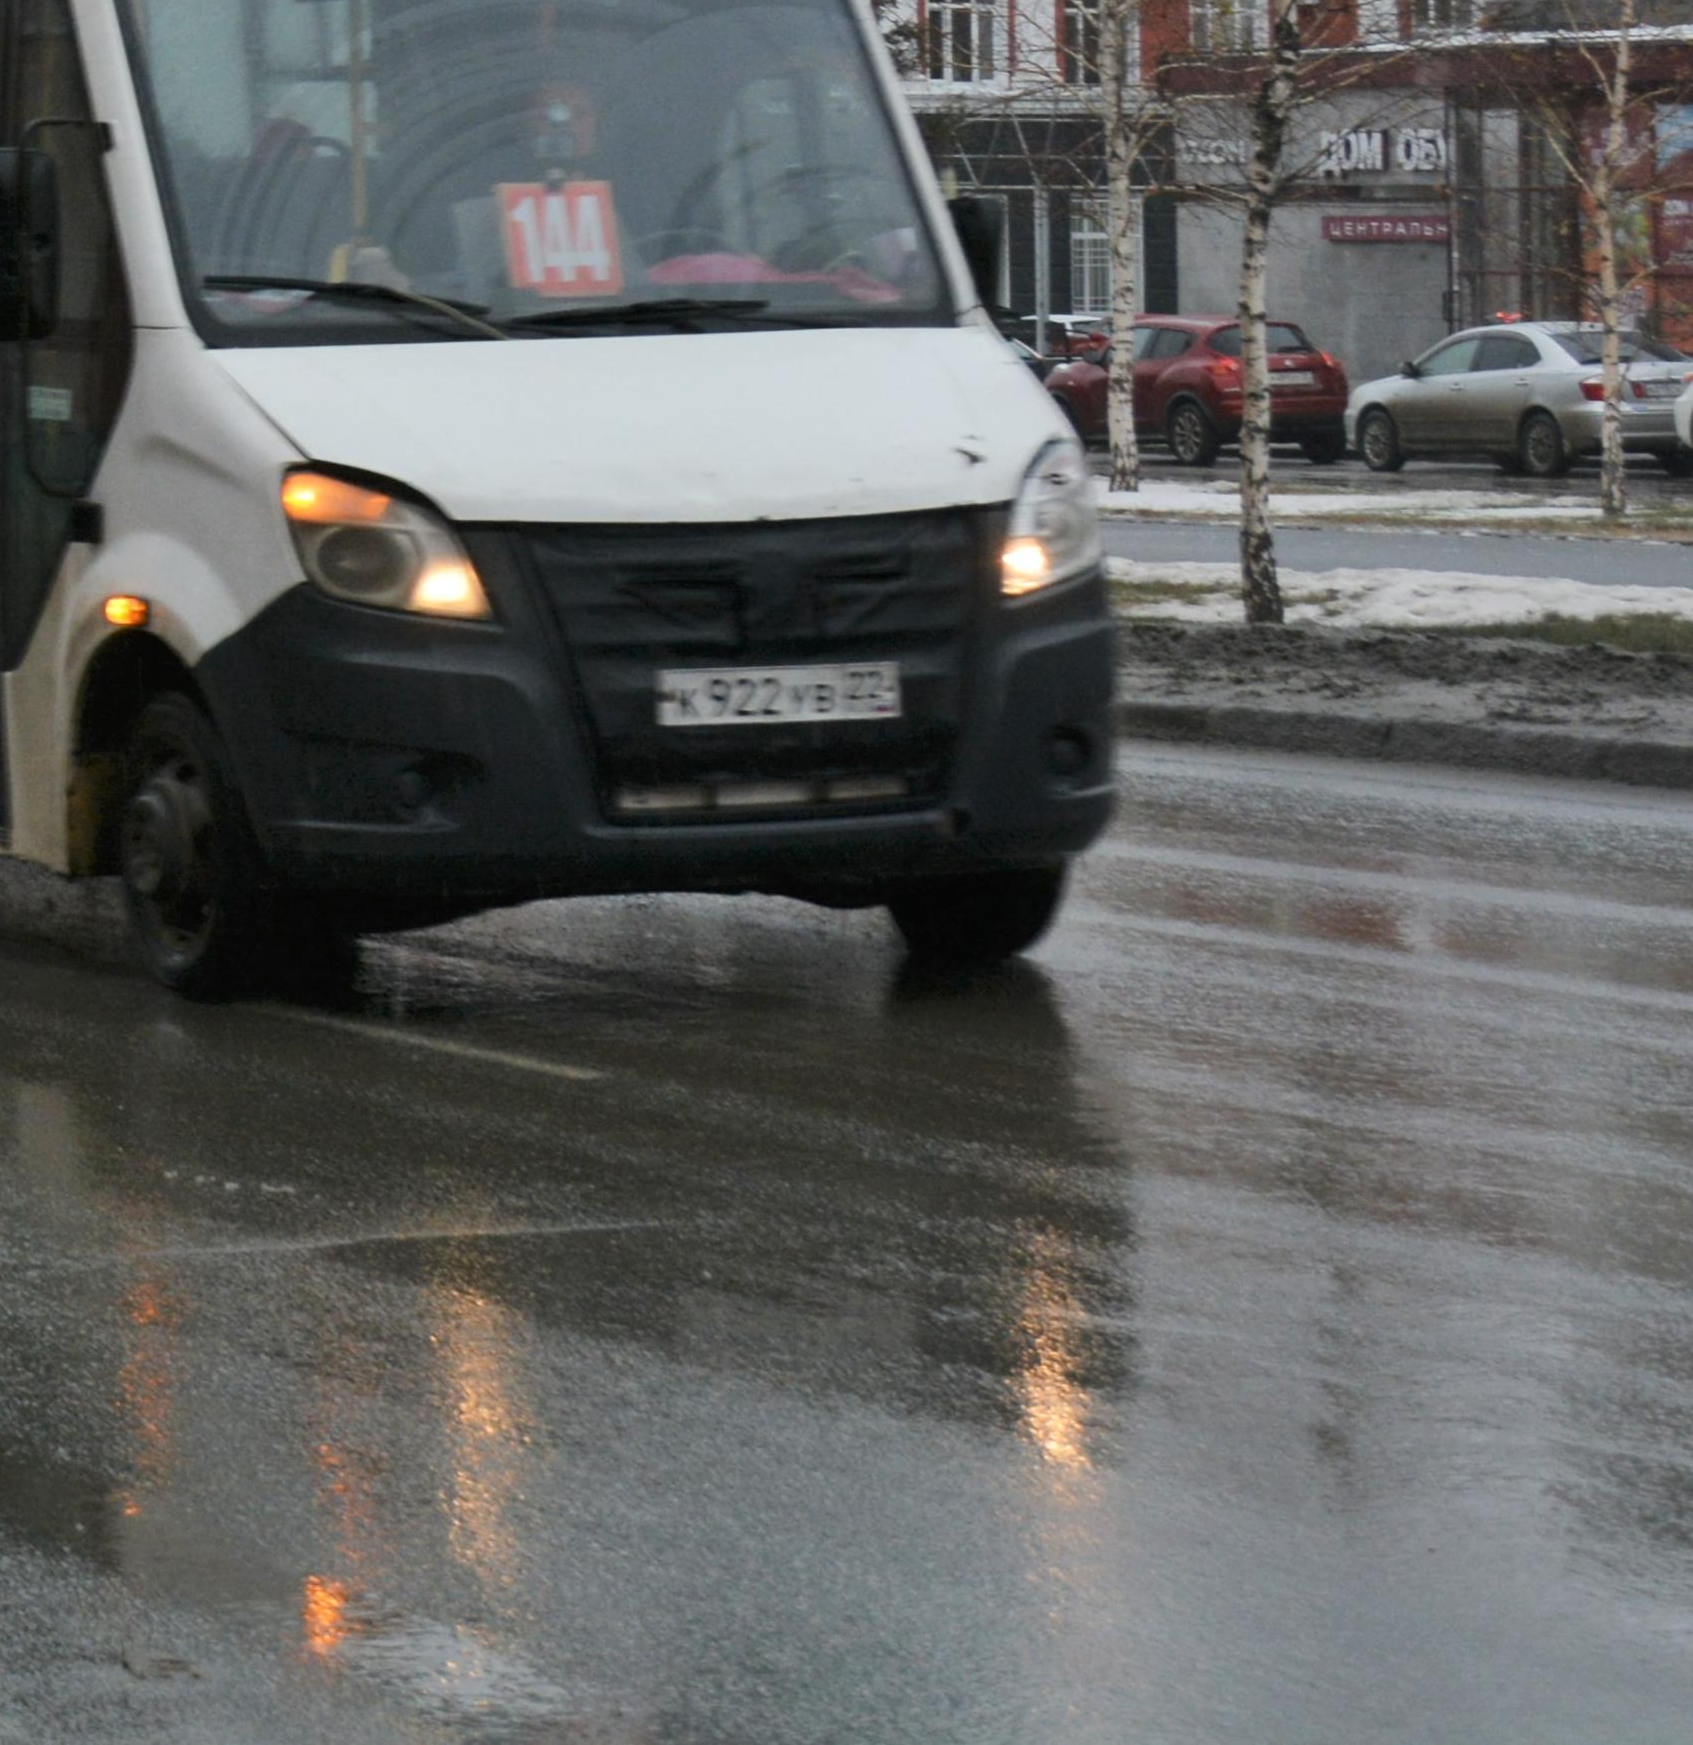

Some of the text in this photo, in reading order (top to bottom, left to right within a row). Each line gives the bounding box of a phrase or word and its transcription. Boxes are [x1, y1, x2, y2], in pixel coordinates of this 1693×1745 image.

[1319, 128, 1384, 176] ДОМ
[509, 194, 611, 283] 144
[1329, 221, 1448, 237] ЦЕНТРАЛЬН
[848, 671, 884, 700] 22
